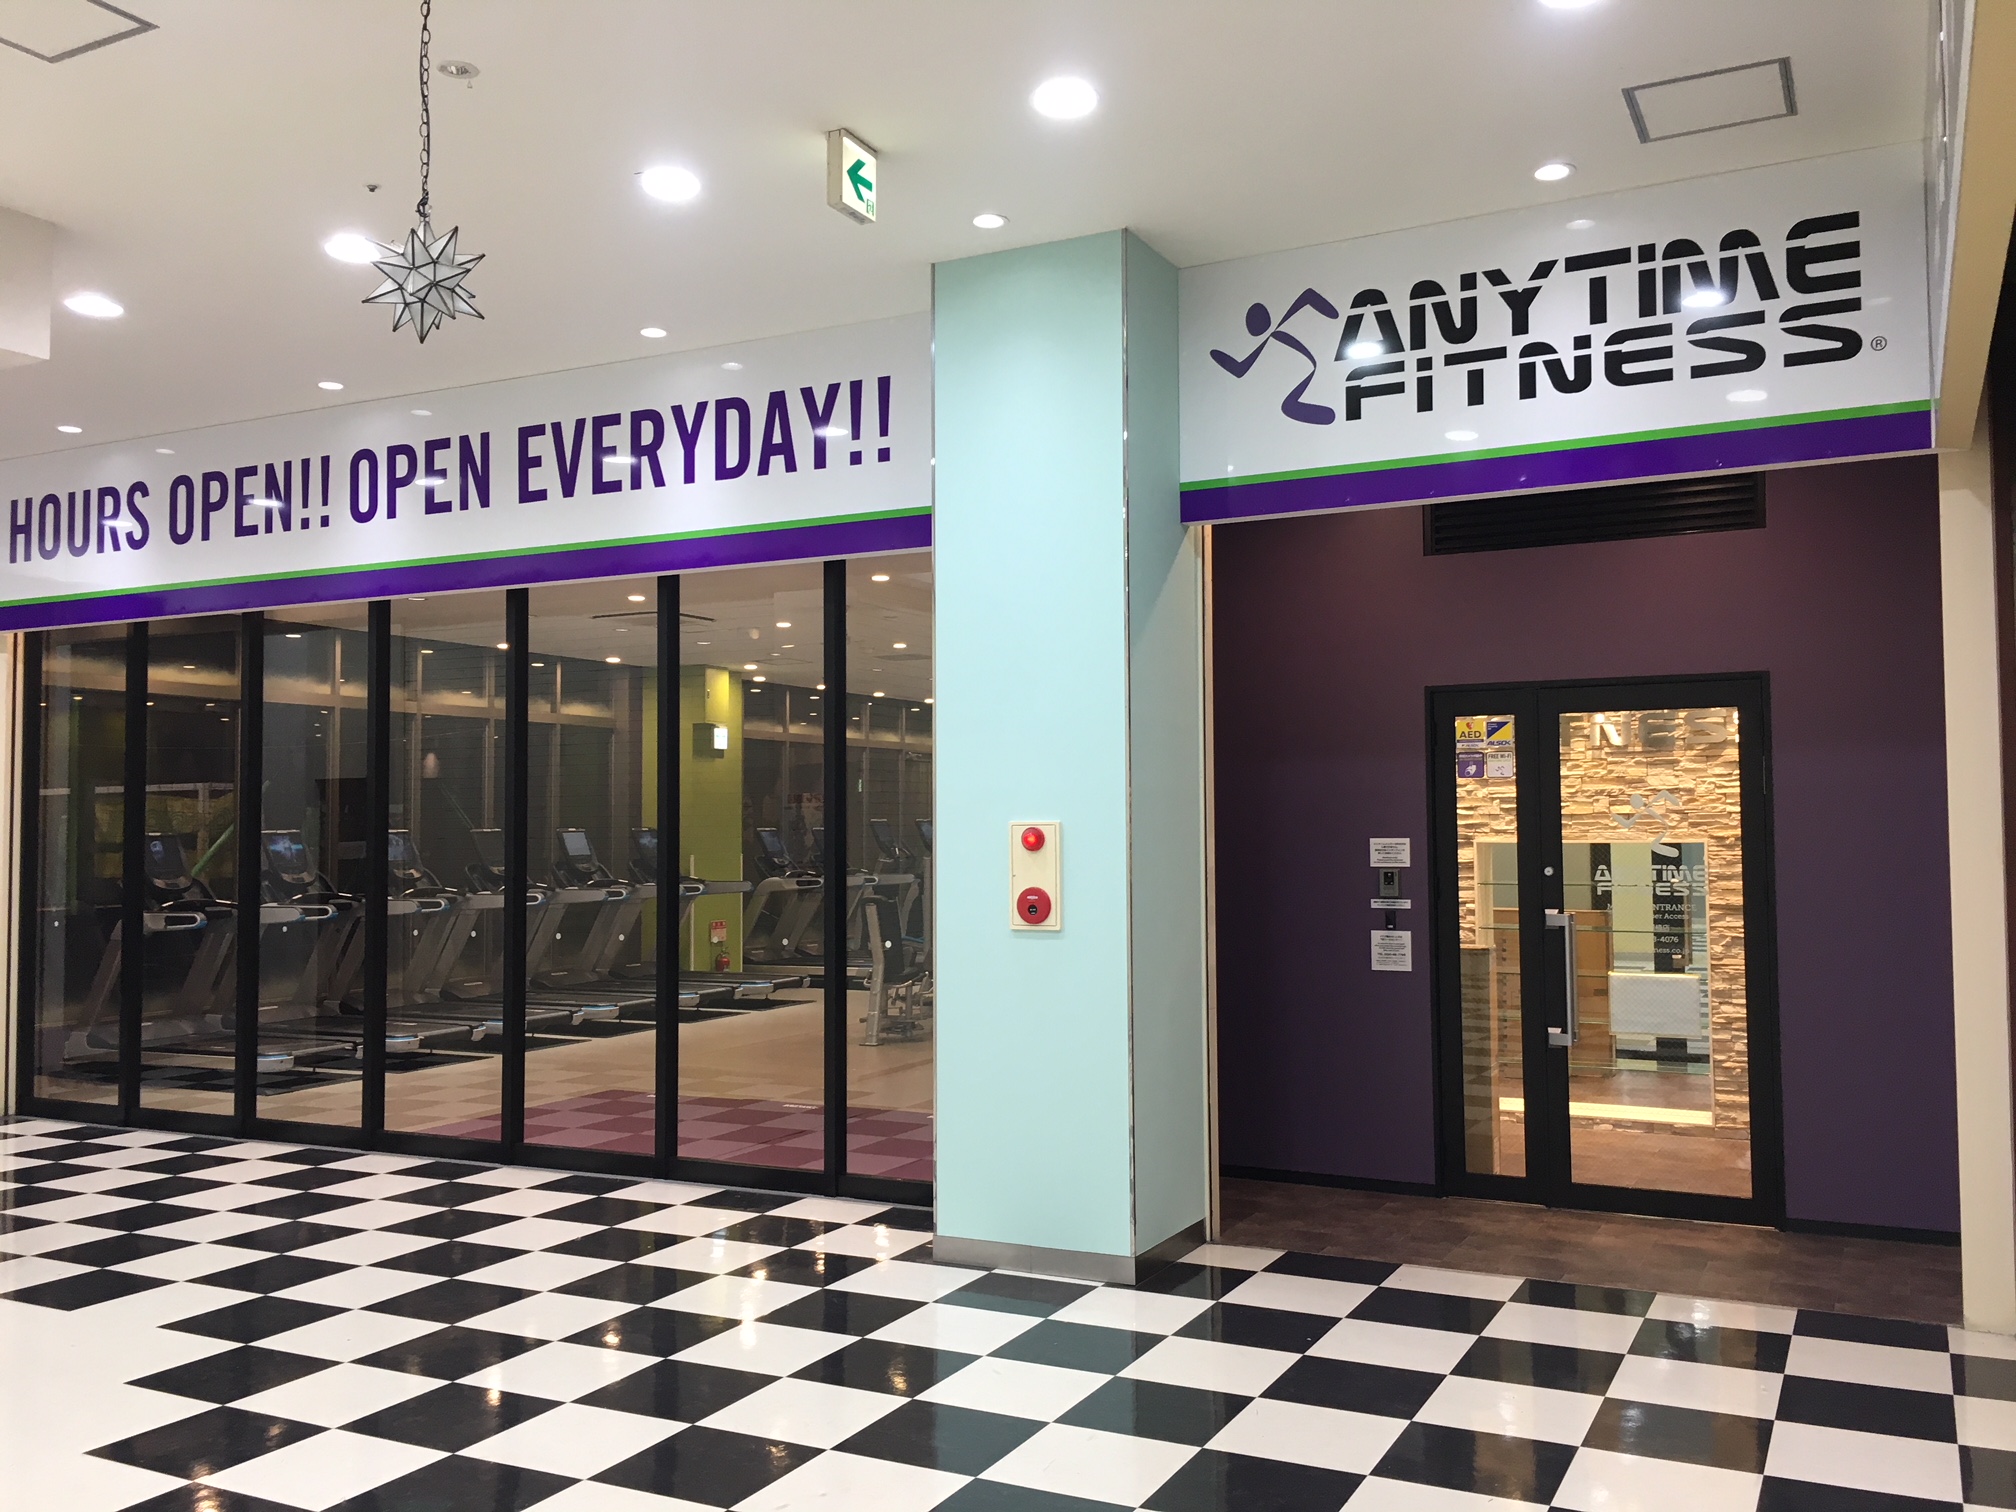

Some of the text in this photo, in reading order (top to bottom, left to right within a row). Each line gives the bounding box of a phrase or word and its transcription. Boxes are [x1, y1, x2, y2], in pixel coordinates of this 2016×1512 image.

[1334, 211, 1861, 362] ANYTIME
[1344, 297, 1864, 421] FITNESS
[9, 375, 892, 564] HOURS OPEN!! OPEN EVERYDAY!!
